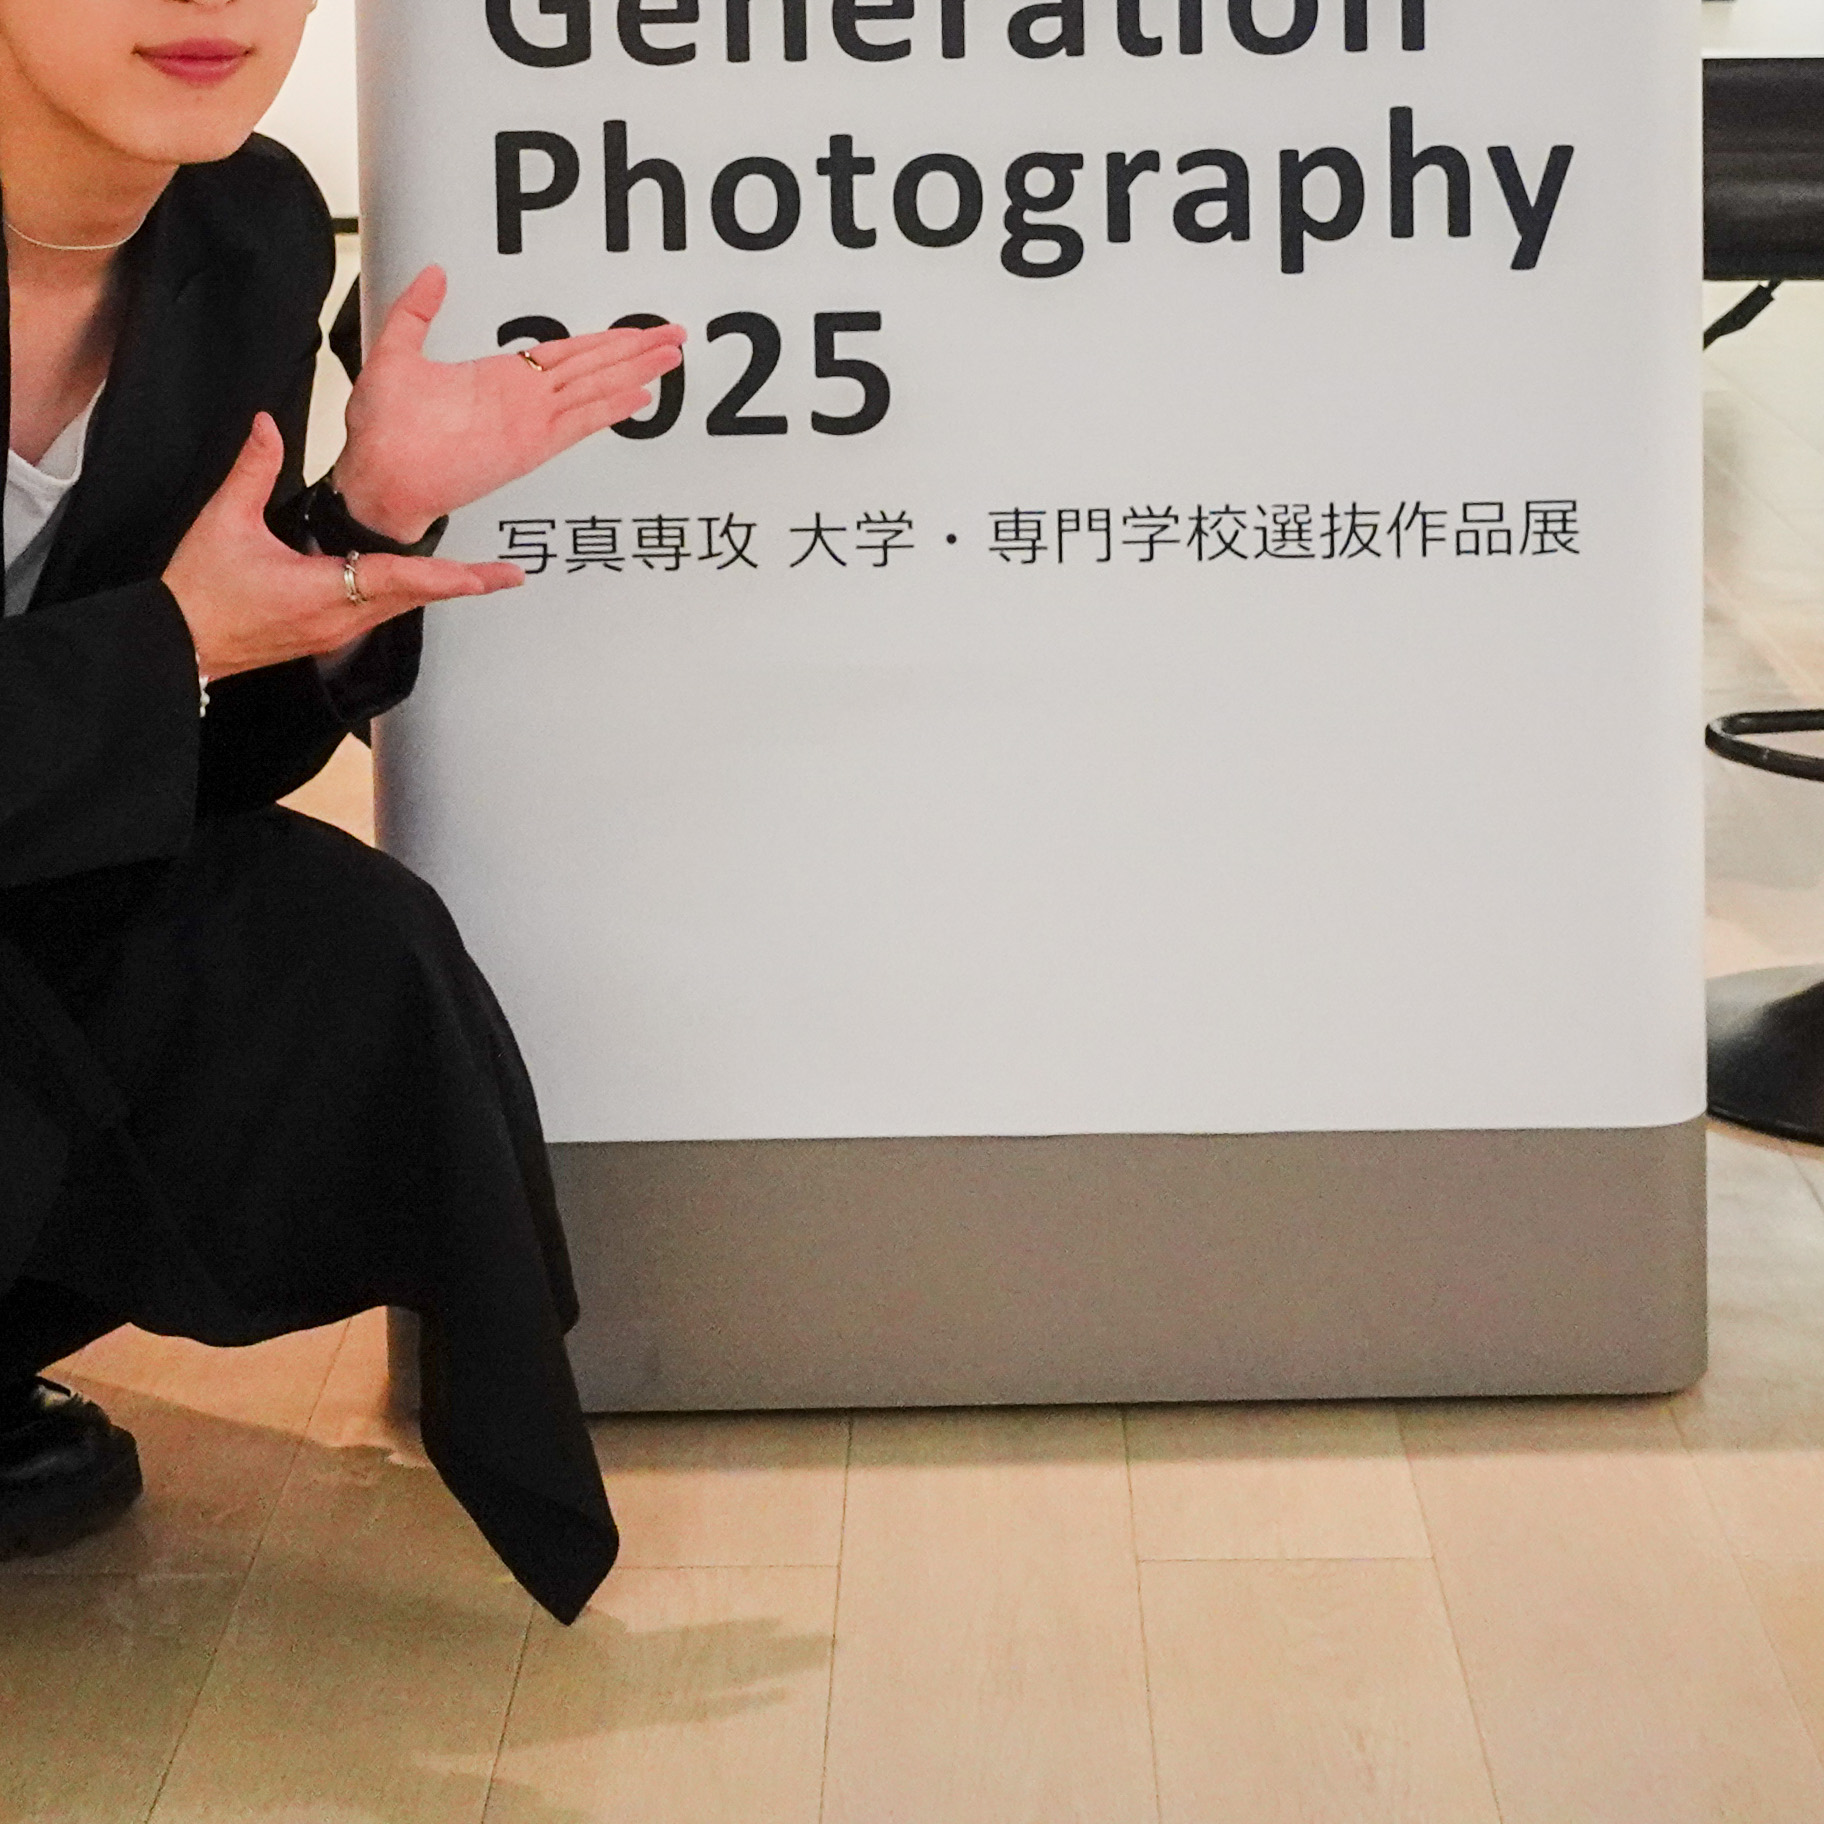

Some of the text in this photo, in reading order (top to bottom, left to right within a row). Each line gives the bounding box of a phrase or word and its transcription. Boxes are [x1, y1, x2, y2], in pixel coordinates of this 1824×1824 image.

[494, 106, 1576, 280] Photography
[497, 311, 892, 441] 025
[498, 499, 1581, 574] 写真専攻 大学・専門学校選抜作品展
